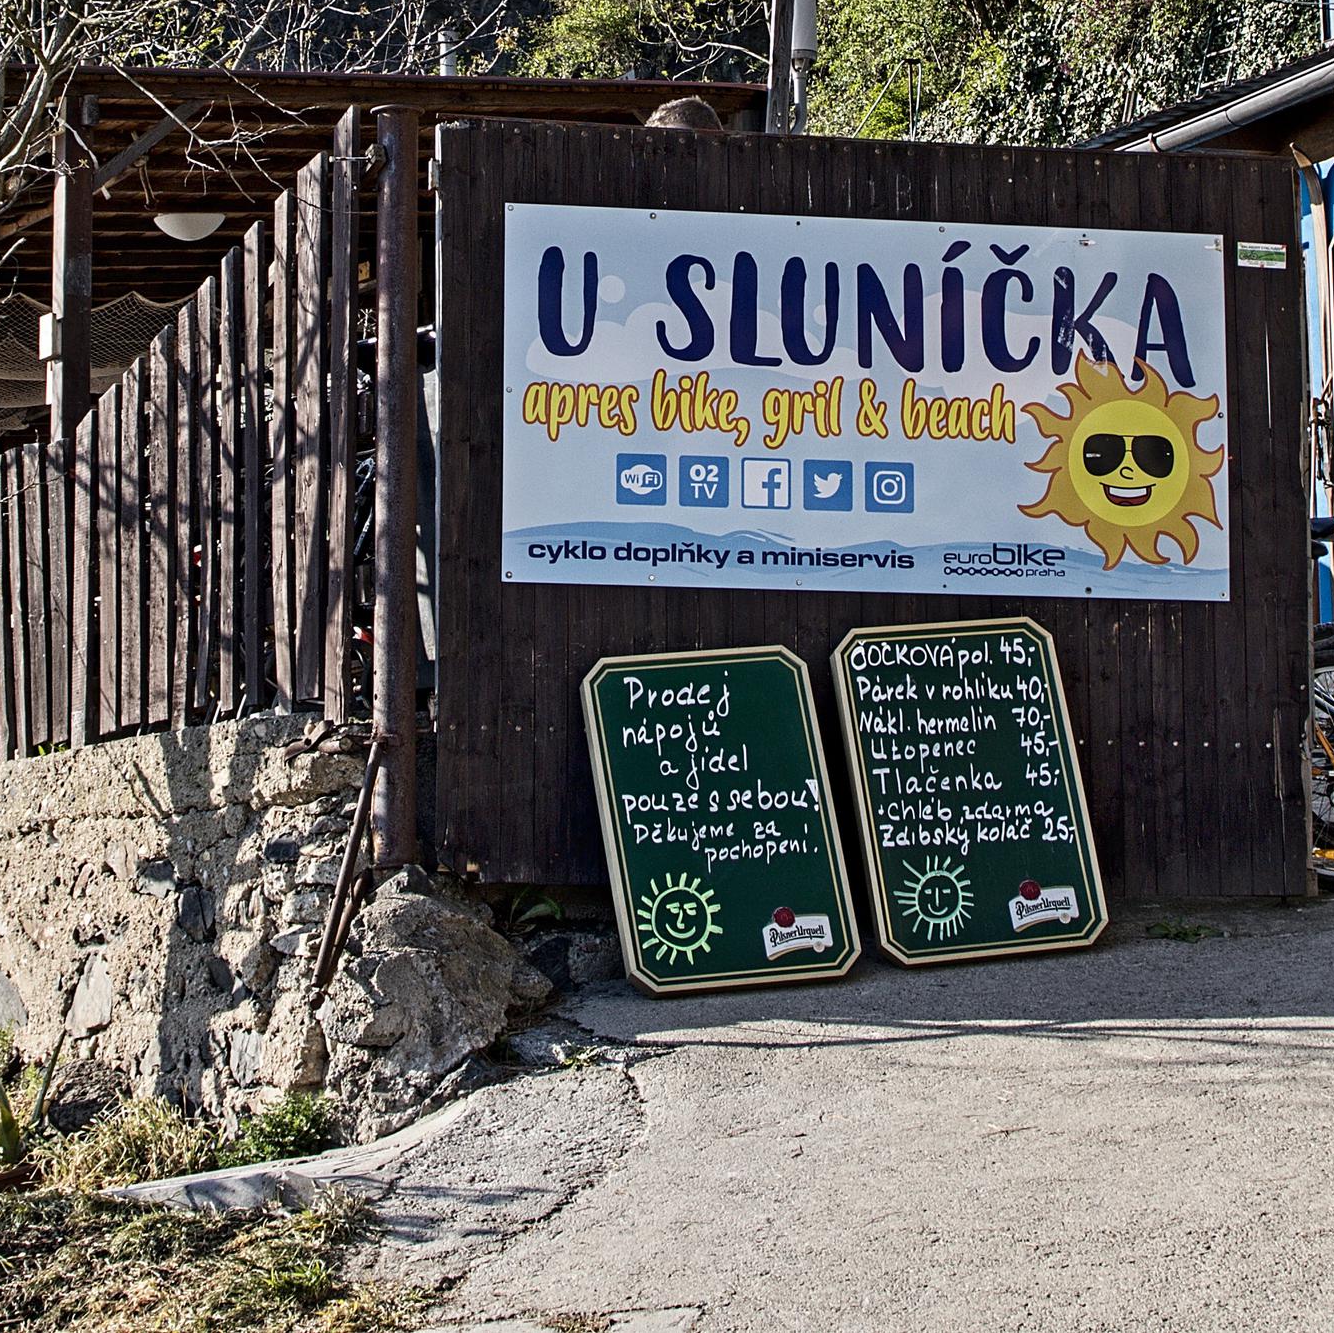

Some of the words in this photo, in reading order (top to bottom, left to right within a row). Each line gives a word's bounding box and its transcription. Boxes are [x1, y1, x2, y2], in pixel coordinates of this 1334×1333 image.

[538, 246, 598, 357] U
[656, 240, 1196, 388] SLUNÍČKA
[523, 381, 639, 441] apres
[651, 369, 750, 447] bike,
[762, 376, 844, 449] gril
[856, 378, 888, 439] &
[901, 378, 1016, 444] beach
[690, 483, 718, 500] TV
[528, 540, 607, 564] cyklo
[614, 542, 731, 569] doplňky
[737, 550, 756, 565] a
[762, 547, 915, 569] miniservis
[944, 543, 1065, 566] eurobike
[1026, 569, 1065, 577] praha
[958, 641, 993, 679] pol.
[623, 670, 730, 717] Prodej
[856, 673, 918, 702] Párek
[926, 685, 935, 699] v
[942, 672, 1013, 701] rohlíku
[623, 710, 720, 757] nápojů
[859, 706, 911, 735] Nákl.
[917, 706, 997, 735] hermelín
[871, 737, 976, 773] Utopenec
[1021, 731, 1059, 757] 45,-
[660, 760, 678, 776] a
[872, 763, 1002, 794] Tlačenka
[622, 792, 699, 824] pouze
[709, 790, 719, 812] s
[727, 779, 819, 811] sebou!
[963, 800, 1054, 822] zdarma
[633, 817, 734, 850] Děkujeme
[753, 820, 781, 839] za
[705, 823, 818, 873] pochopení.
[879, 817, 970, 855] Zdibský
[977, 818, 1032, 843] koláč
[1016, 900, 1044, 920] Pilsner
[1041, 896, 1070, 911] Urquell
[769, 928, 797, 947] Pilsner
[795, 925, 825, 940] Urquell
